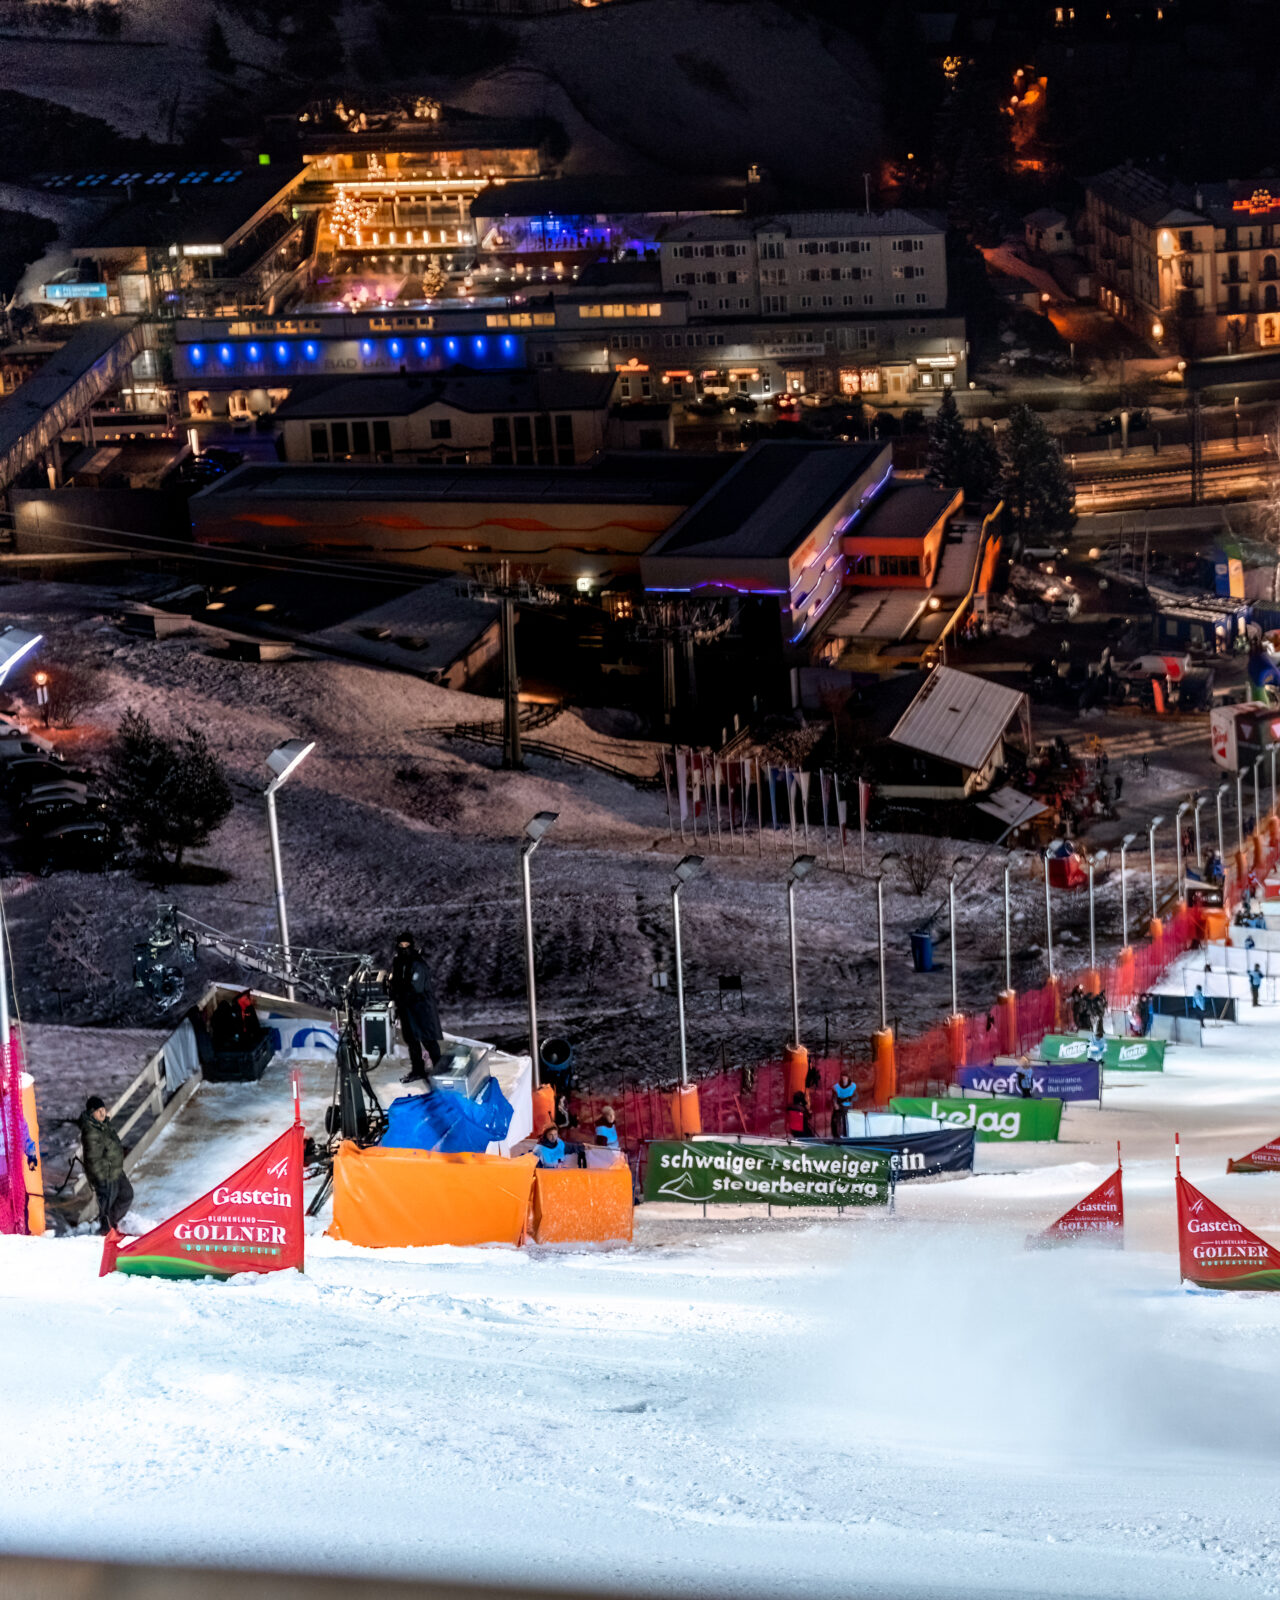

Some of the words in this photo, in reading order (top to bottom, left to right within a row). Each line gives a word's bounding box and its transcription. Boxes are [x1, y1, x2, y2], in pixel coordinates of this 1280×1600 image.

[972, 1072, 1044, 1094] wefx
[660, 1148, 765, 1174] schwaiger
[767, 1158, 780, 1169] +
[782, 1153, 879, 1176] schweiger
[711, 1176, 877, 1197] steuerberatung
[212, 1186, 292, 1207] Gastein
[1076, 1201, 1117, 1212] Gastein
[208, 1215, 256, 1223] BLUMENLAND
[1187, 1219, 1243, 1233] Gastein
[173, 1223, 287, 1244] GOLLNER
[186, 1244, 277, 1255] DORFGASTEIN
[1193, 1246, 1269, 1259] GOLLNER
